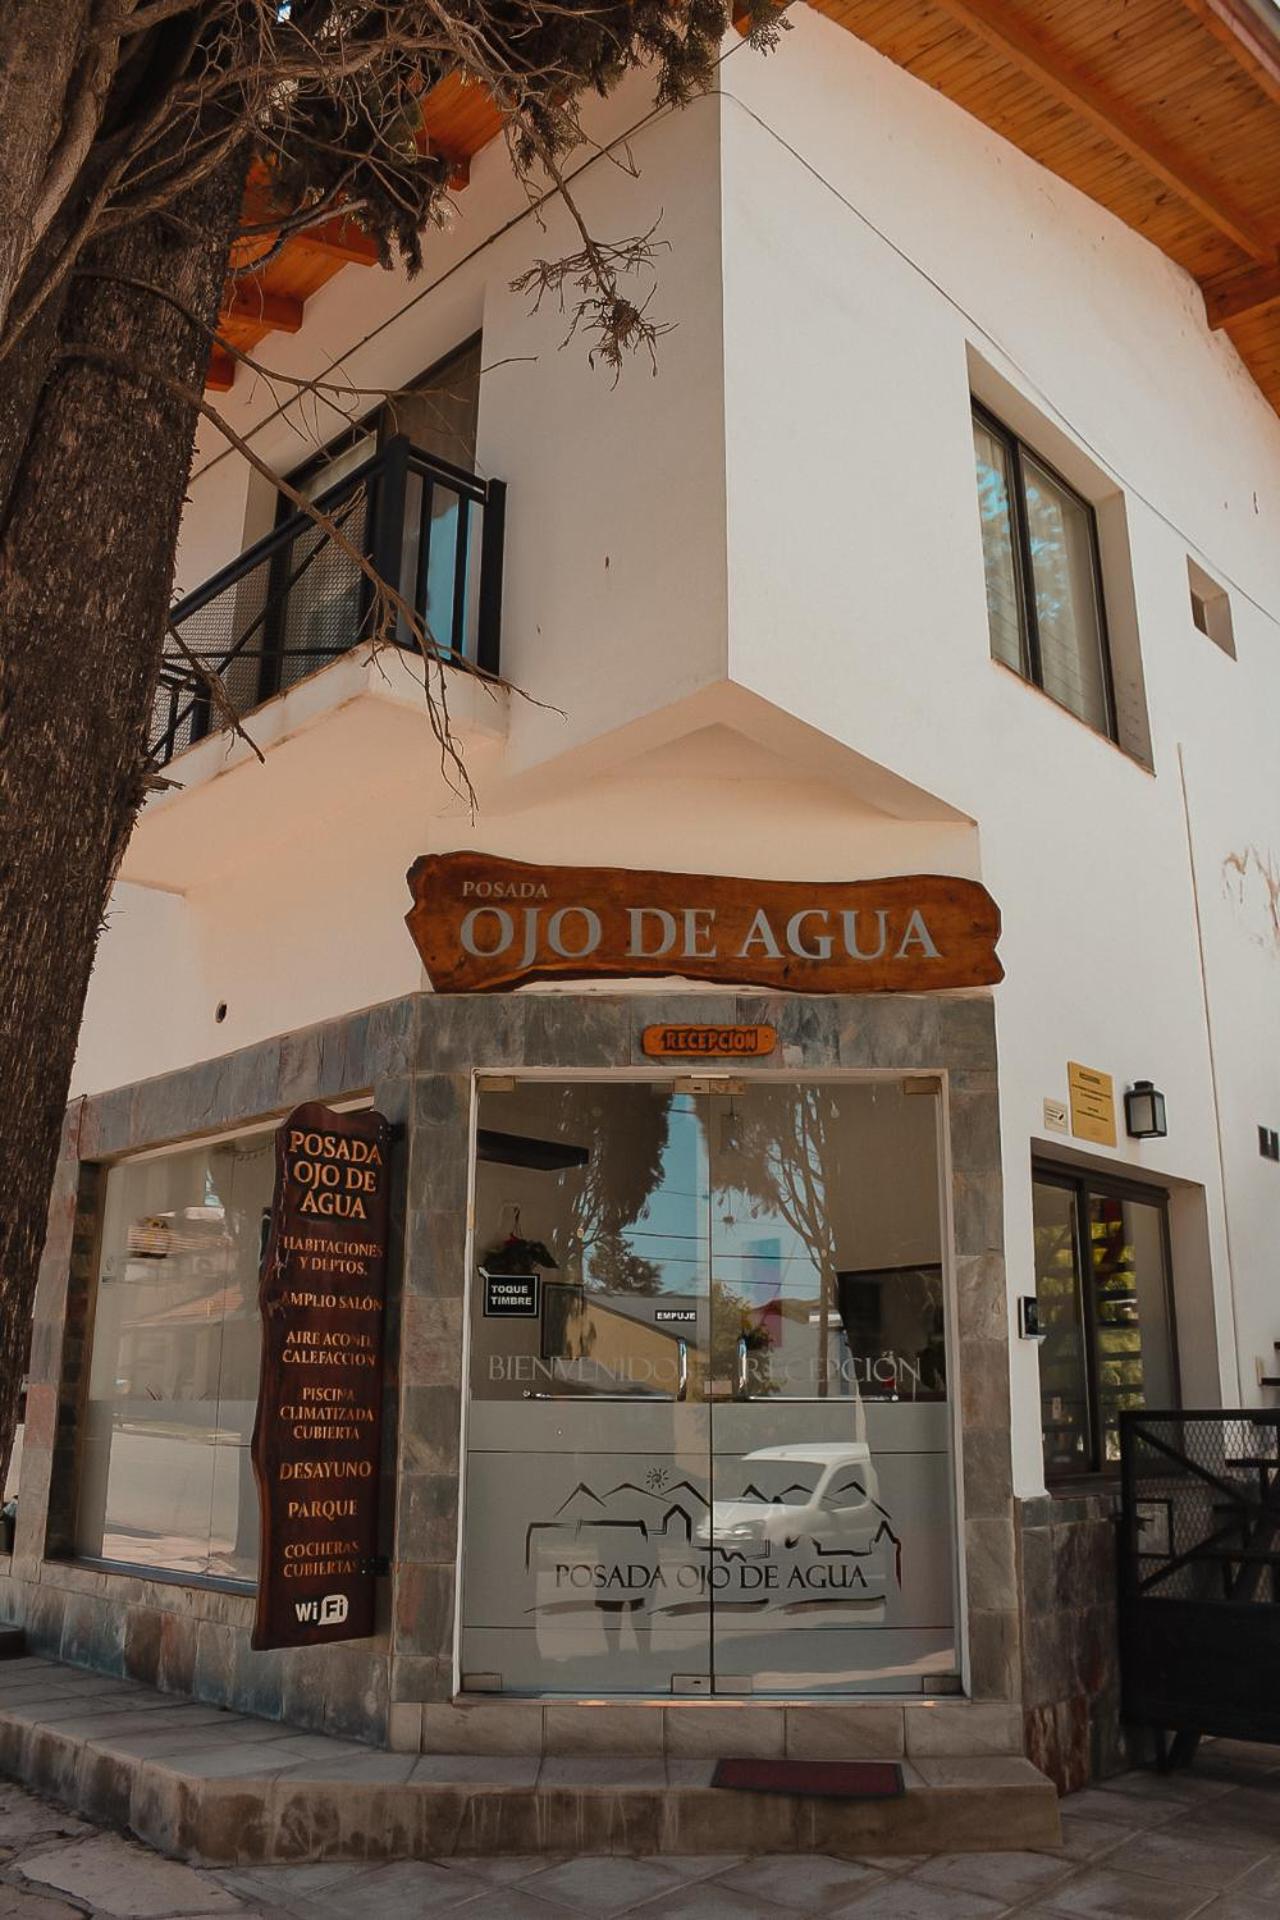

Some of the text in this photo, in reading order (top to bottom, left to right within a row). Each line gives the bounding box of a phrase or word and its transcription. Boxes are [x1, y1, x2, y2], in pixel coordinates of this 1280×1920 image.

[461, 880, 549, 899] POSADA
[459, 906, 943, 969] OJO DE AGUA
[289, 1130, 382, 1166] POSADA
[294, 1161, 376, 1192] OJO DE
[300, 1190, 367, 1219] AGUA
[283, 1236, 383, 1257] HABITACIONES
[299, 1256, 308, 1269] Y
[491, 1285, 528, 1294] TOQUE
[281, 1291, 383, 1311] AMPLIO SALÓN
[491, 1297, 532, 1306] TIMBRE
[656, 1311, 696, 1320] EMPUJE
[286, 1331, 320, 1345] AIRE
[302, 1387, 354, 1401] PISCINA
[280, 1406, 374, 1422] CLIMATIZADA
[293, 1425, 360, 1440] CUBIERTA
[280, 1461, 372, 1480] DESAYUNO
[288, 1500, 358, 1521] PARQUE
[284, 1541, 360, 1558] COCHERAS
[555, 1564, 869, 1596] POSADA OJO DE AGUA
